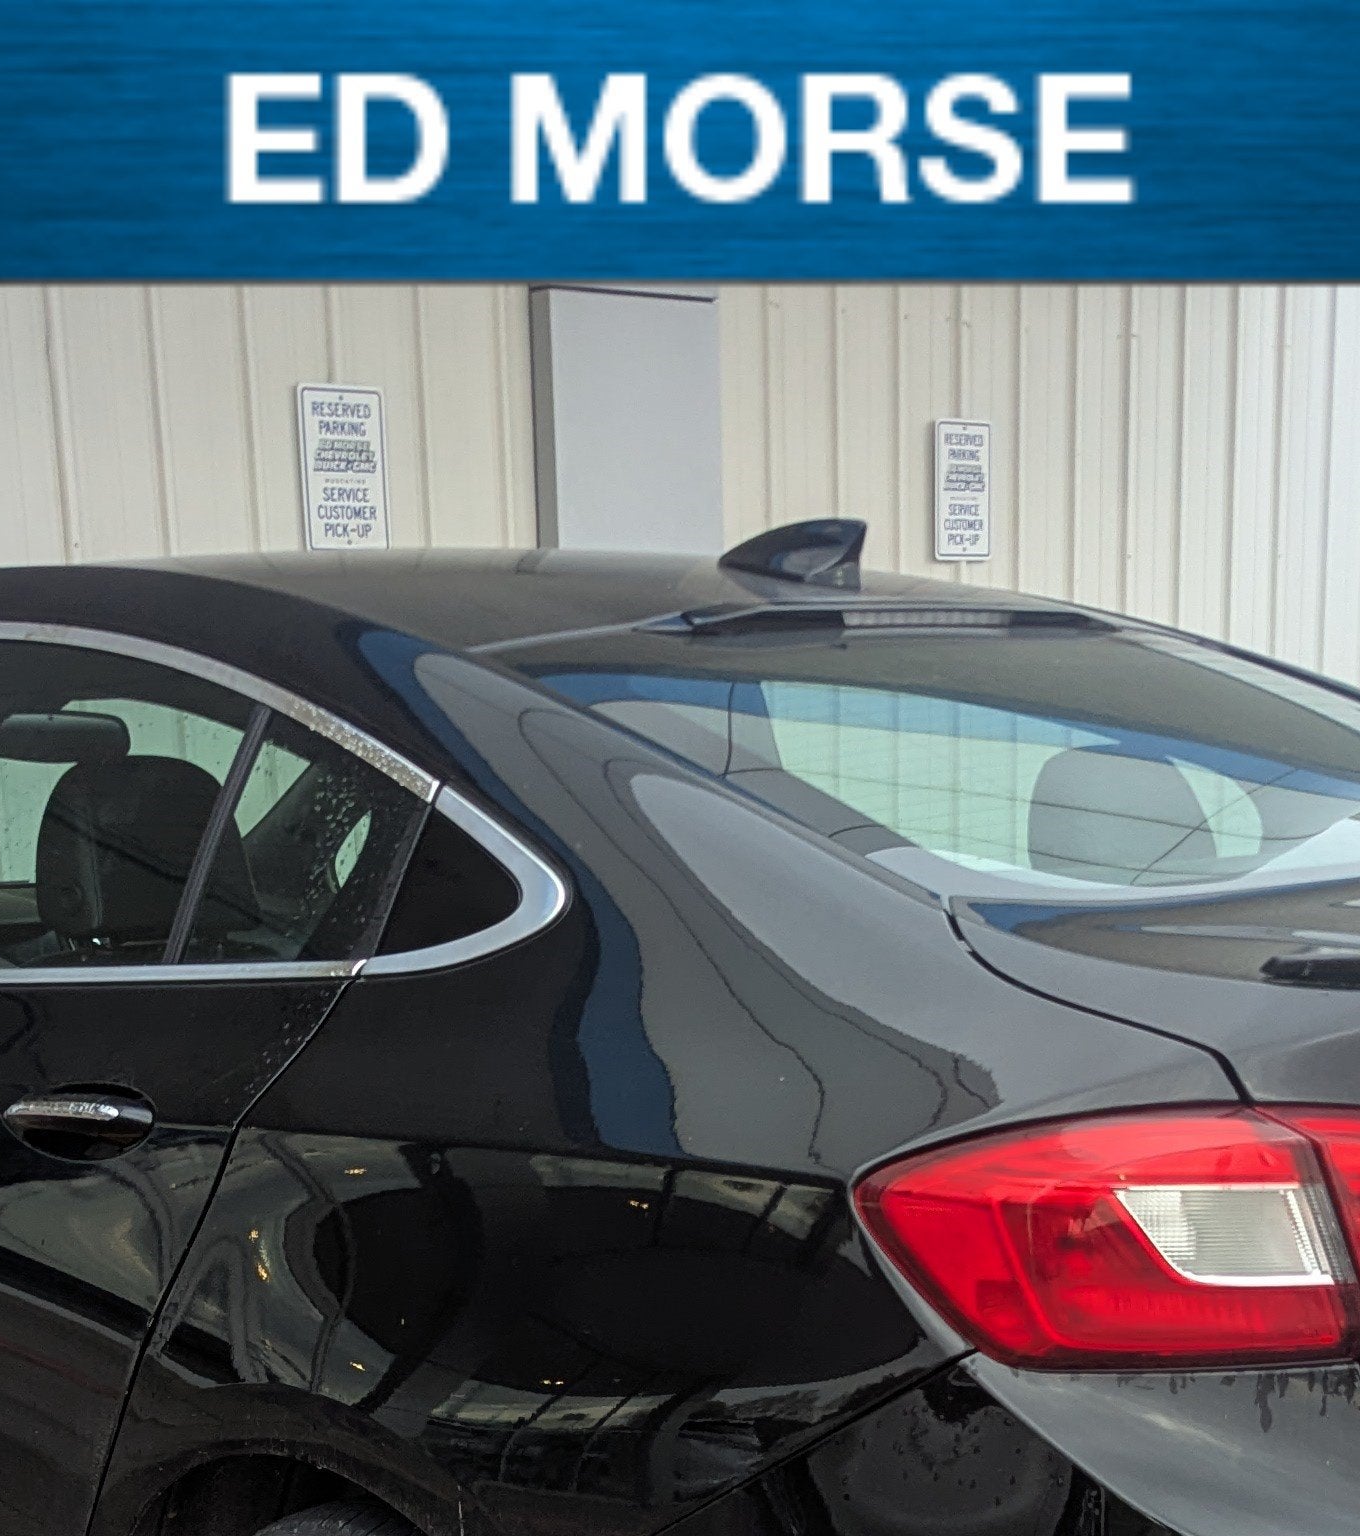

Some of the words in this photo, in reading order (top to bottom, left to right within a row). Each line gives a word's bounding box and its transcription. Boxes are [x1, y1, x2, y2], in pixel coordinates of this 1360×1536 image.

[311, 401, 371, 419] RESERVED
[318, 420, 366, 437] PARKING
[944, 433, 984, 447] RESERVED
[948, 449, 980, 462] PARKING
[322, 487, 370, 503] SERVICE
[317, 504, 377, 521] CUSTOMER
[948, 504, 980, 516] SERVICE
[324, 523, 372, 538] PICK-UP
[944, 518, 983, 531] CUSTOMER
[948, 534, 980, 546] PICK-UP
